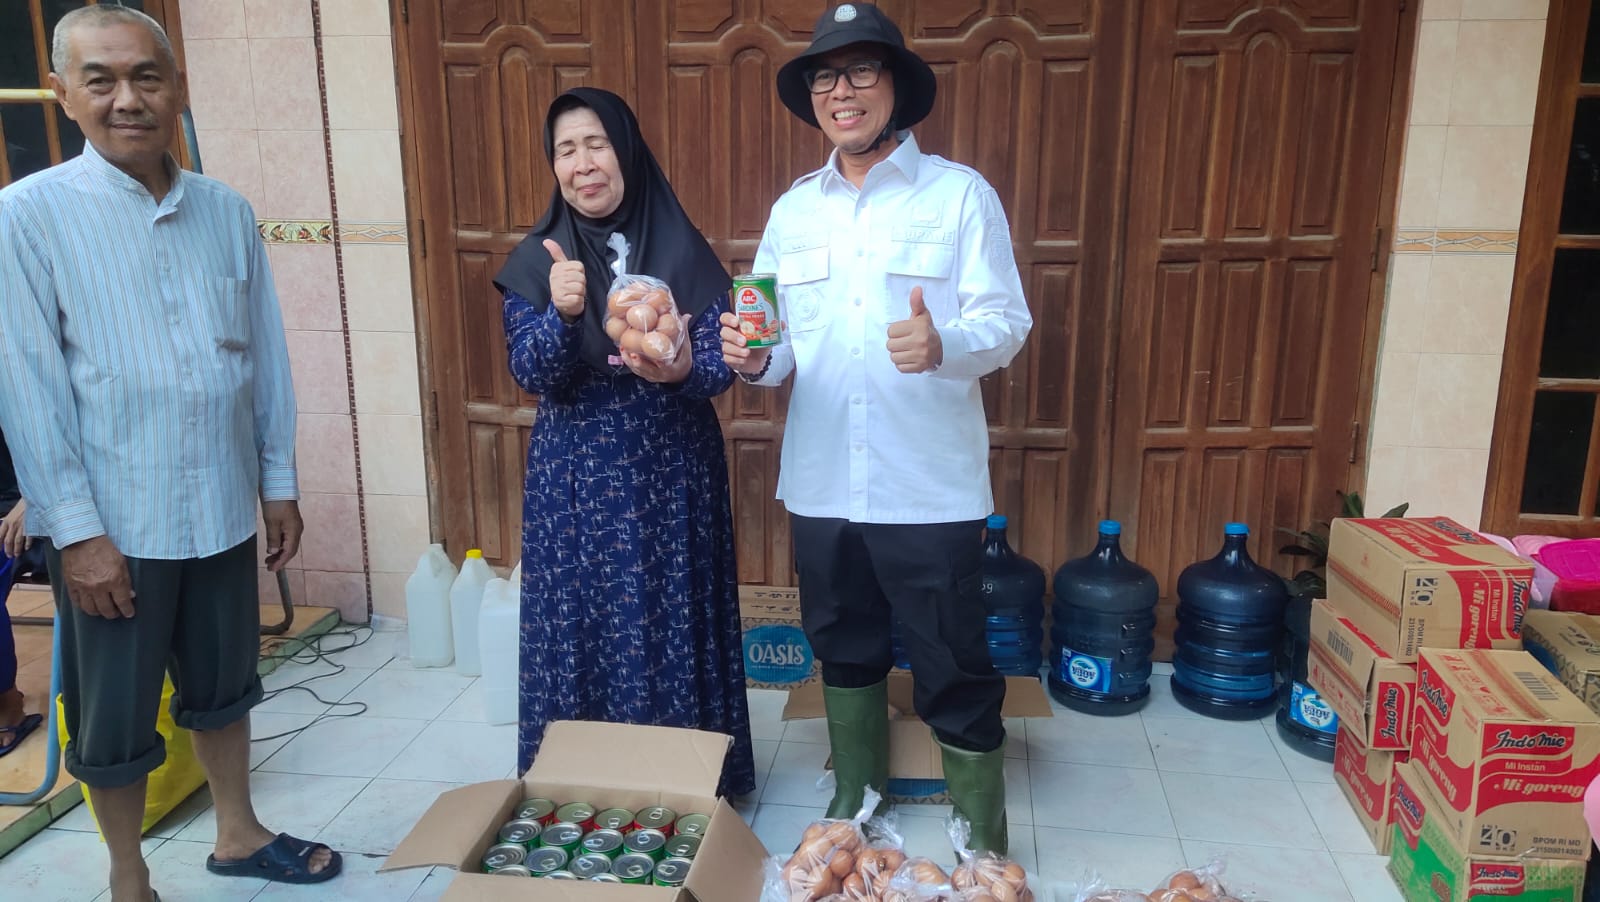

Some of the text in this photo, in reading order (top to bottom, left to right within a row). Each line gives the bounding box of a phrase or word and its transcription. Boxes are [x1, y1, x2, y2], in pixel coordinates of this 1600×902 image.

[748, 642, 805, 666] OASIS
[1303, 703, 1331, 721] AQUA
[1518, 762, 1546, 772] Instan
[1503, 778, 1585, 798] Mi goreng
[1533, 836, 1557, 846] BPOM
[1568, 839, 1581, 847] MD
